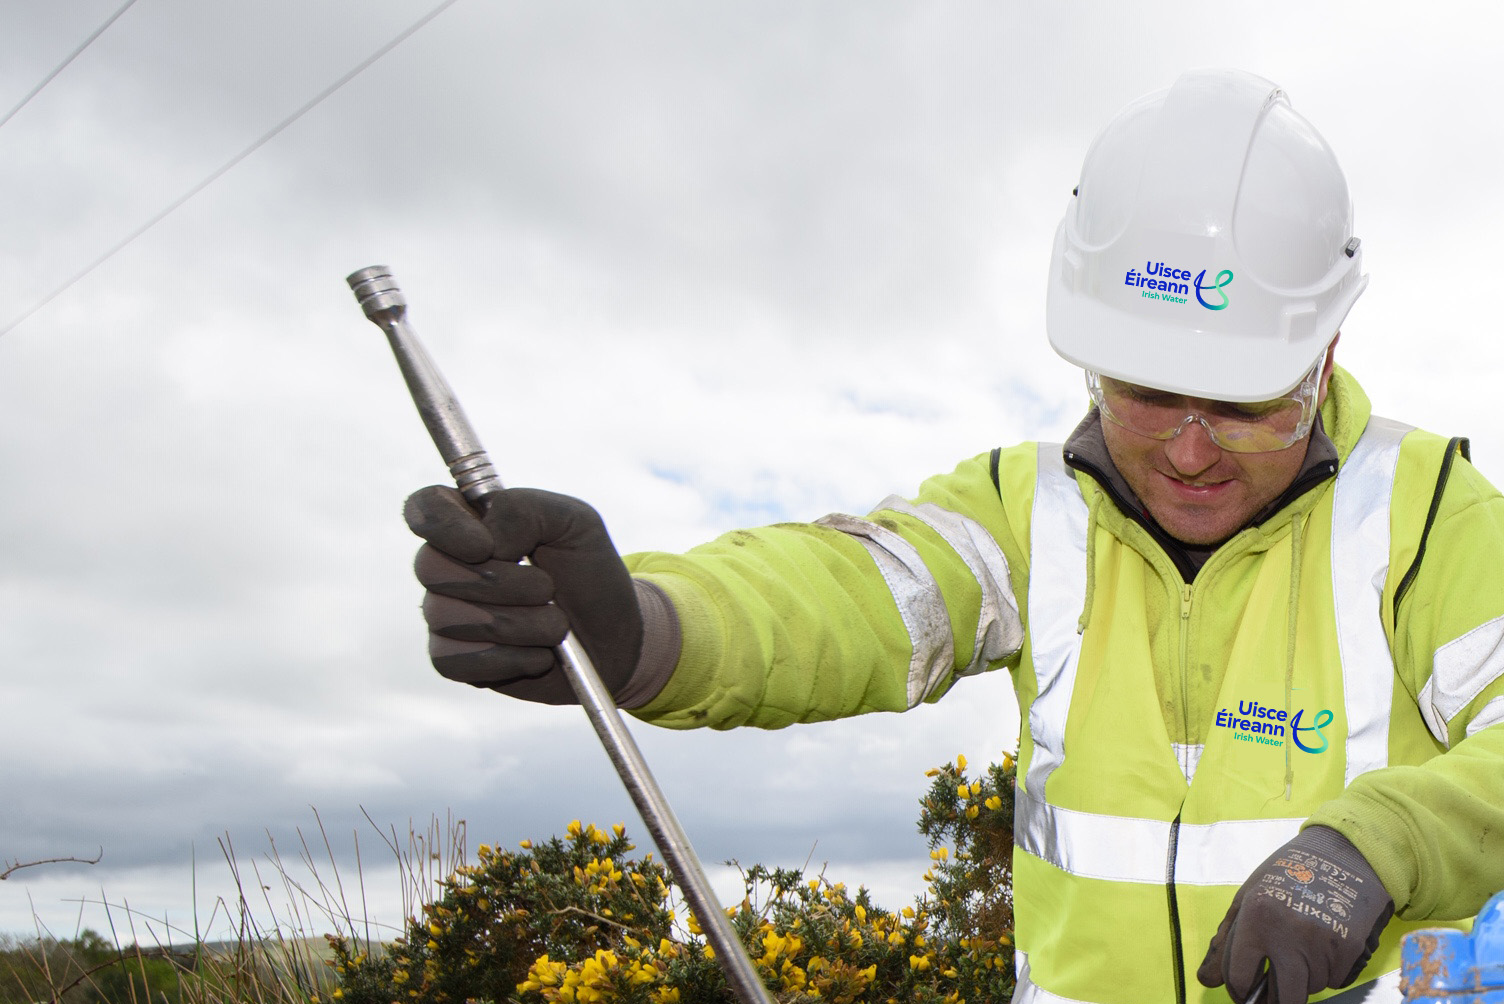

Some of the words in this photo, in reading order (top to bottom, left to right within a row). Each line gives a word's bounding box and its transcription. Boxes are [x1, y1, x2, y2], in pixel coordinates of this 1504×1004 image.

[1124, 269, 1189, 295] Éireann
[1146, 261, 1191, 281] Uisce
[1141, 290, 1160, 300] Irish
[1161, 293, 1187, 304] Water
[1238, 700, 1288, 722] Uisce
[1215, 708, 1285, 737] Éireann
[1233, 732, 1254, 743] Irish
[1255, 736, 1284, 748] Water
[1262, 887, 1349, 940] MaxiFlex
